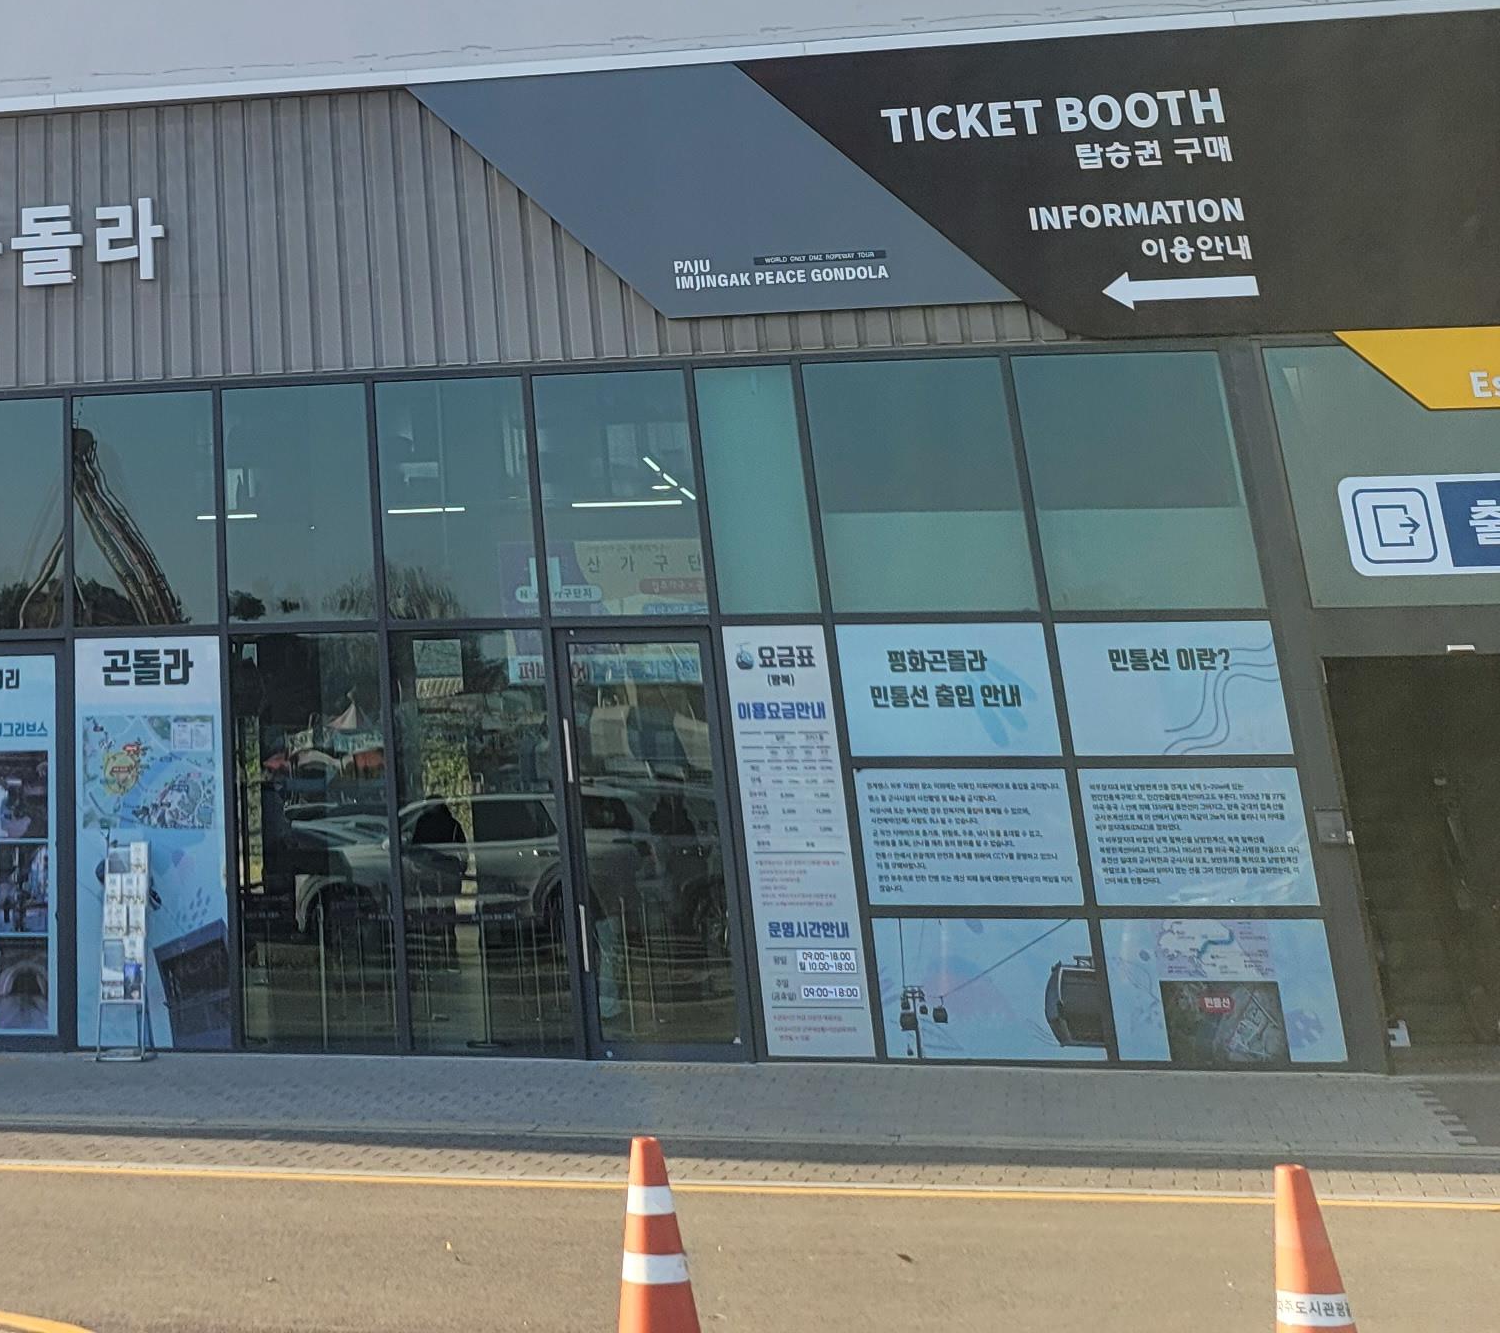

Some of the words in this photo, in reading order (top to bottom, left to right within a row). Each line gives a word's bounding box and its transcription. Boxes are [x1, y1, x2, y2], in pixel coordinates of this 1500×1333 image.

[880, 99, 1043, 143] TICKET
[1055, 87, 1226, 133] BOOTH
[1075, 140, 1163, 170] 탑승권
[1173, 136, 1234, 164] 구매
[1028, 197, 1245, 231] INFORMATION
[1141, 234, 1253, 264] 이용안내
[673, 259, 711, 276] PAJU
[675, 272, 751, 291] IMJINGAK
[754, 268, 807, 286] PEACE
[810, 264, 890, 283] GONDOLA
[102, 648, 194, 686] 곤돌라
[758, 646, 816, 668] 요금표
[887, 649, 988, 673] 평화곤돌라
[1108, 648, 1170, 671] 민통선
[1176, 648, 1230, 671] 이란?
[870, 685, 930, 708] 민통선
[935, 684, 976, 708] 출입
[980, 684, 1022, 707] 안내
[737, 701, 826, 720] 이용요금안내
[768, 921, 850, 938] 운영시간안내
